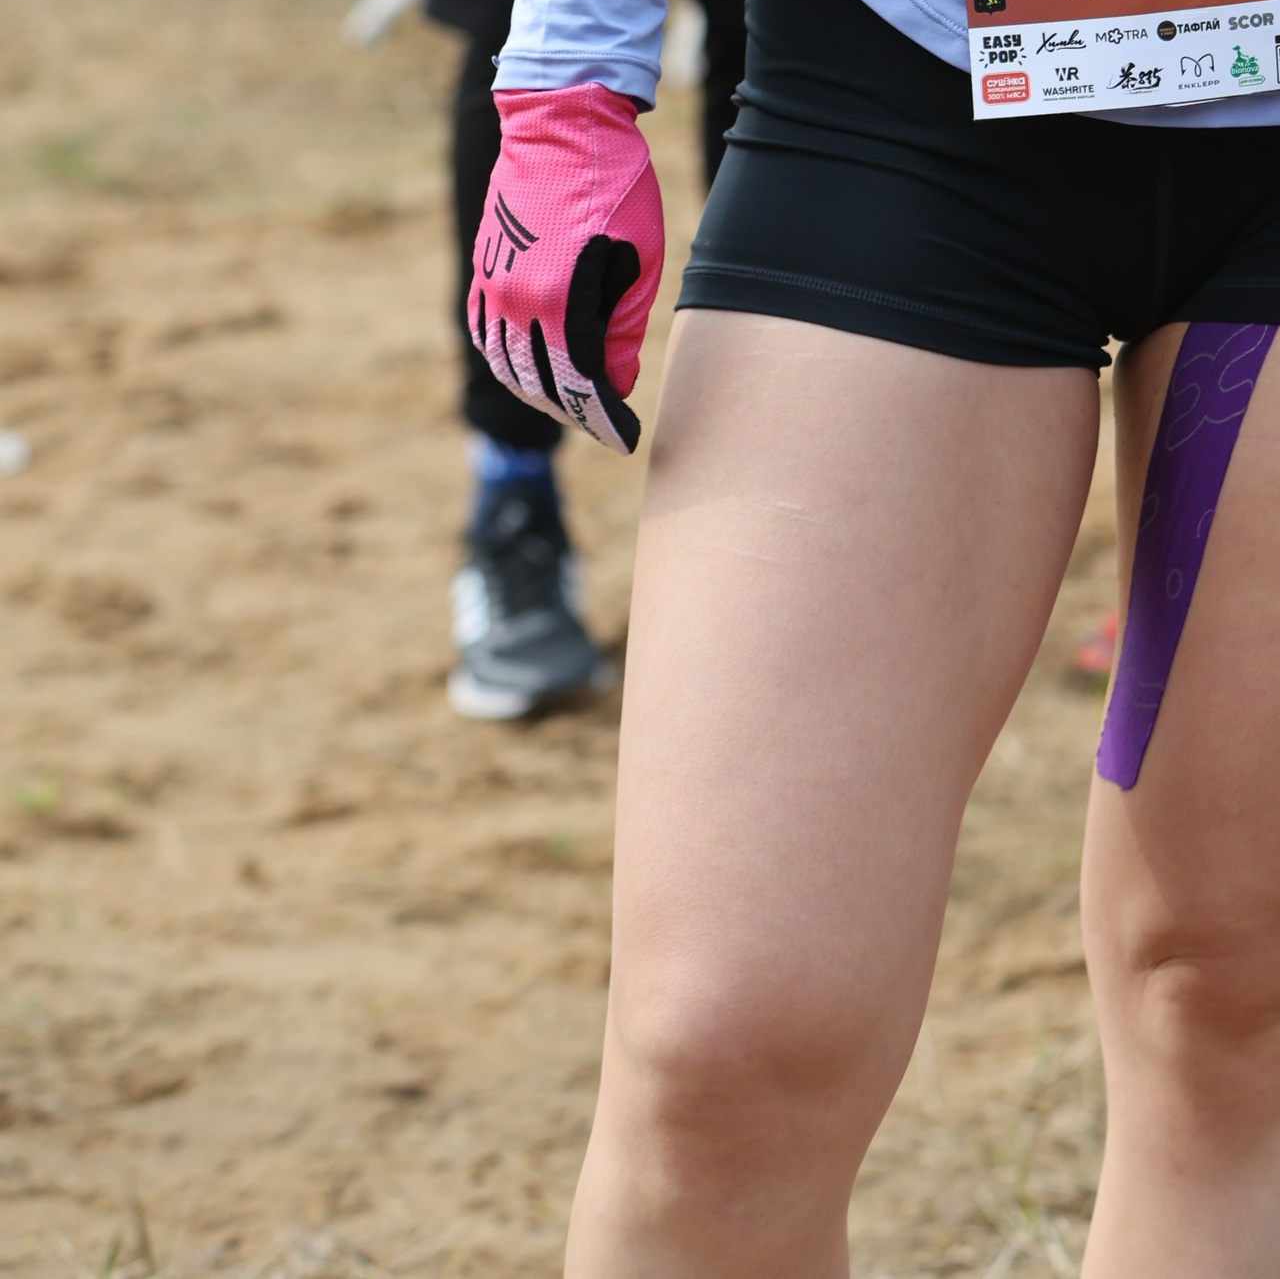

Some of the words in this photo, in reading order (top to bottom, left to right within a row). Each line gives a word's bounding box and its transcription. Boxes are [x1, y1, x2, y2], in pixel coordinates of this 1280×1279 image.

[1176, 18, 1221, 34] ТАФГАЙ
[1228, 12, 1275, 31] SCOR
[983, 34, 1022, 49] EASY
[988, 50, 1018, 64] POP
[1231, 66, 1259, 75] bionova
[1042, 85, 1094, 96] WASHRITE
[1178, 79, 1221, 90] ENKLEPP
